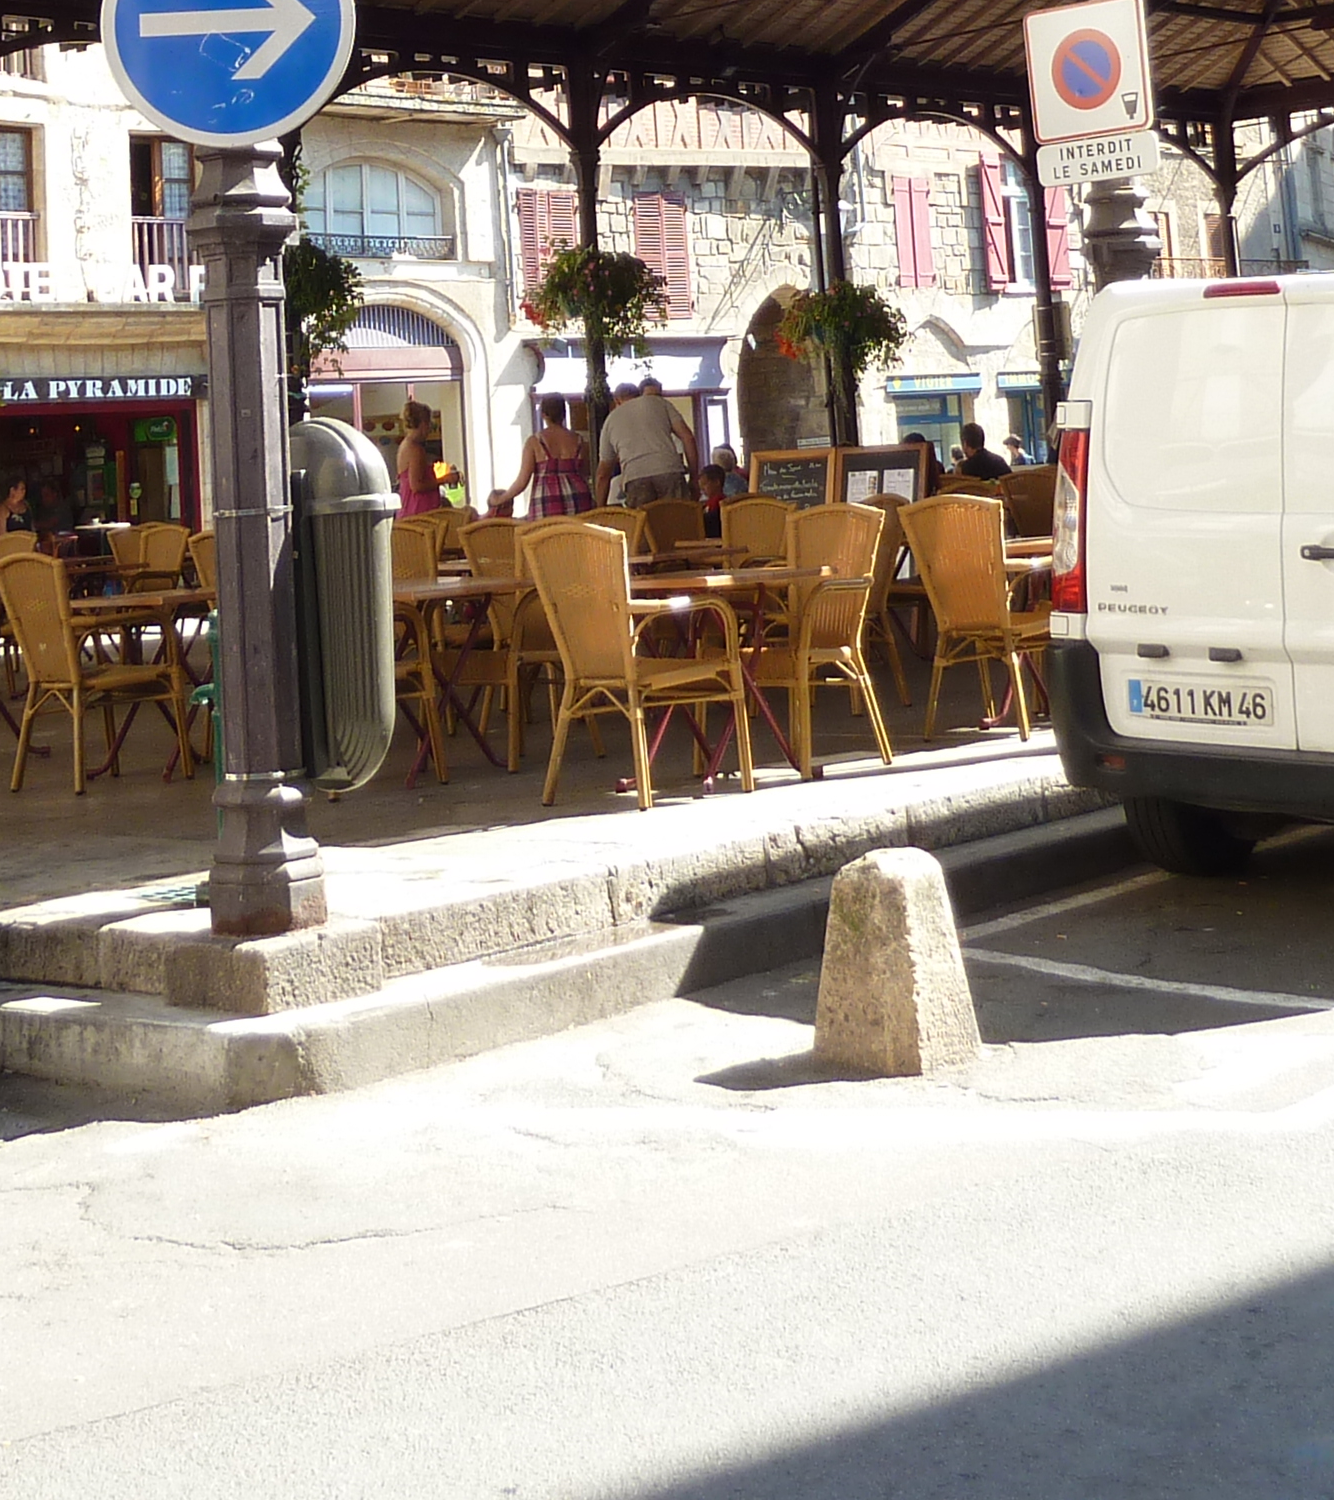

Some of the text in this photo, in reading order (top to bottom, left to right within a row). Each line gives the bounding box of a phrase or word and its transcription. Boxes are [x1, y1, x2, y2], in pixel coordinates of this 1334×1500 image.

[1059, 138, 1133, 161] INTERDIT
[1053, 155, 1142, 180] LE SAMEDI
[98, 264, 175, 303] AR
[1, 377, 192, 400] LA PYRAMIDE
[1097, 602, 1169, 615] PEUGEOT
[1143, 686, 1195, 715] 4611
[1203, 689, 1232, 718] KM
[1238, 692, 1266, 720] 46
